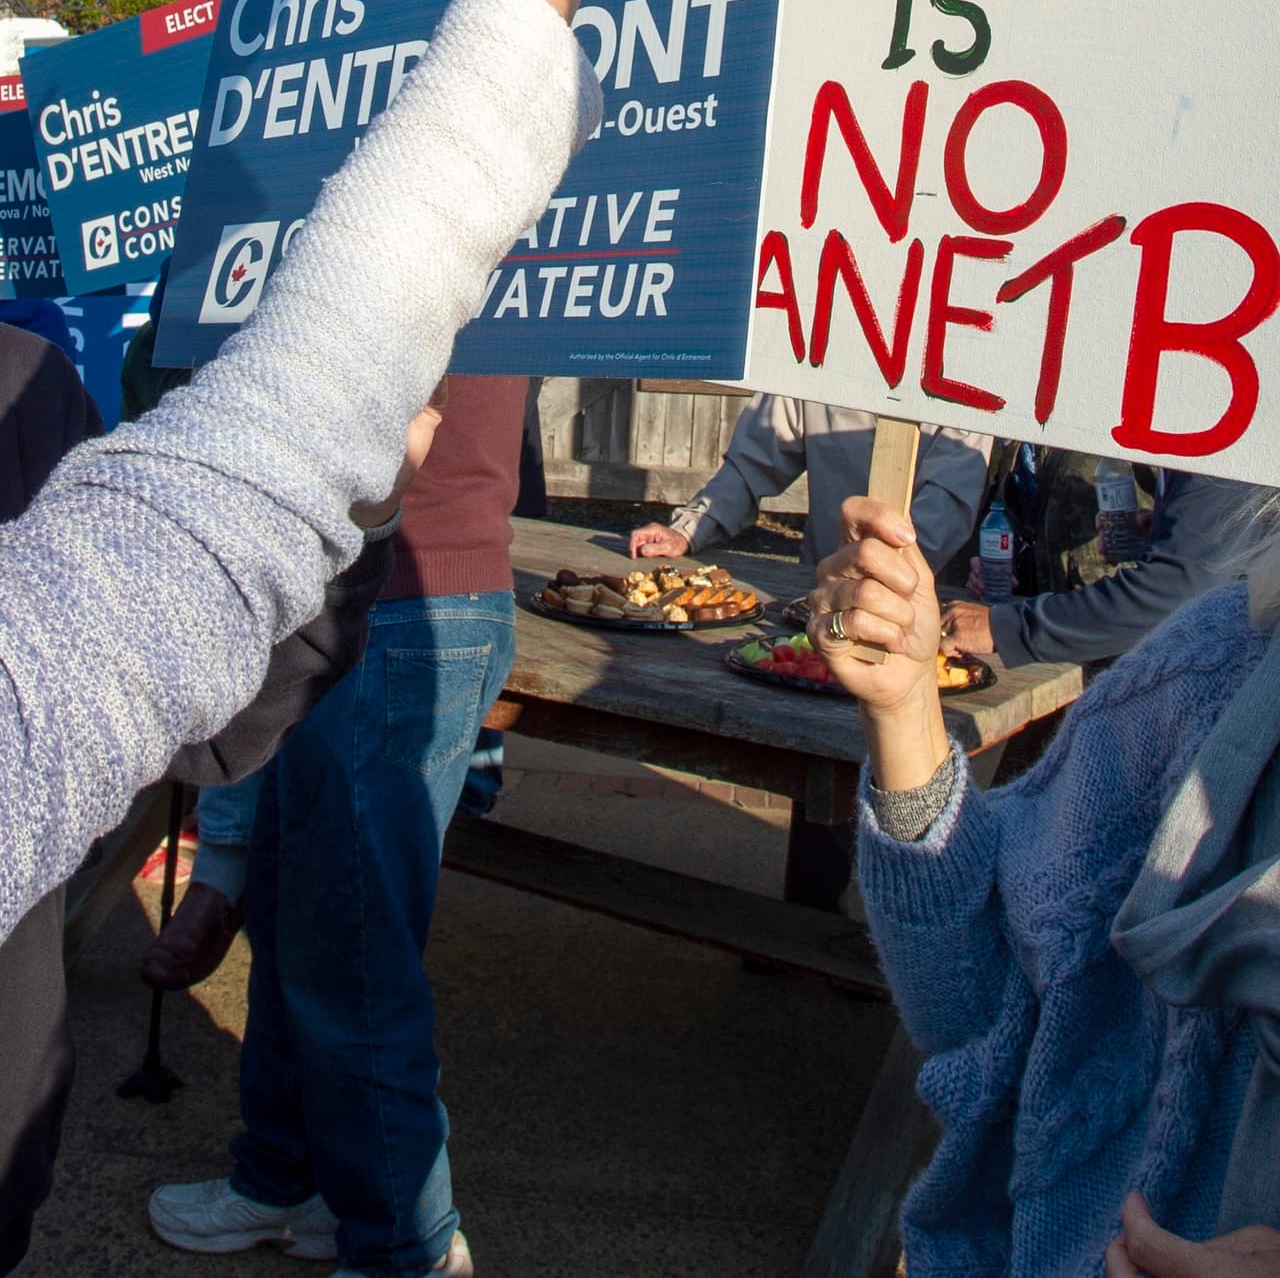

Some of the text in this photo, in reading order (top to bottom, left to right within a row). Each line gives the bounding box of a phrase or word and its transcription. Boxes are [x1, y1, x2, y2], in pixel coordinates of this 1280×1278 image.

[165, 1, 214, 34] ELECT
[0, 83, 25, 102] ELE
[40, 90, 122, 146] Chris
[47, 108, 199, 192] D'ENTRE
[139, 162, 174, 183] West
[799, 79, 1068, 243] NO
[756, 215, 1127, 430] ANET
